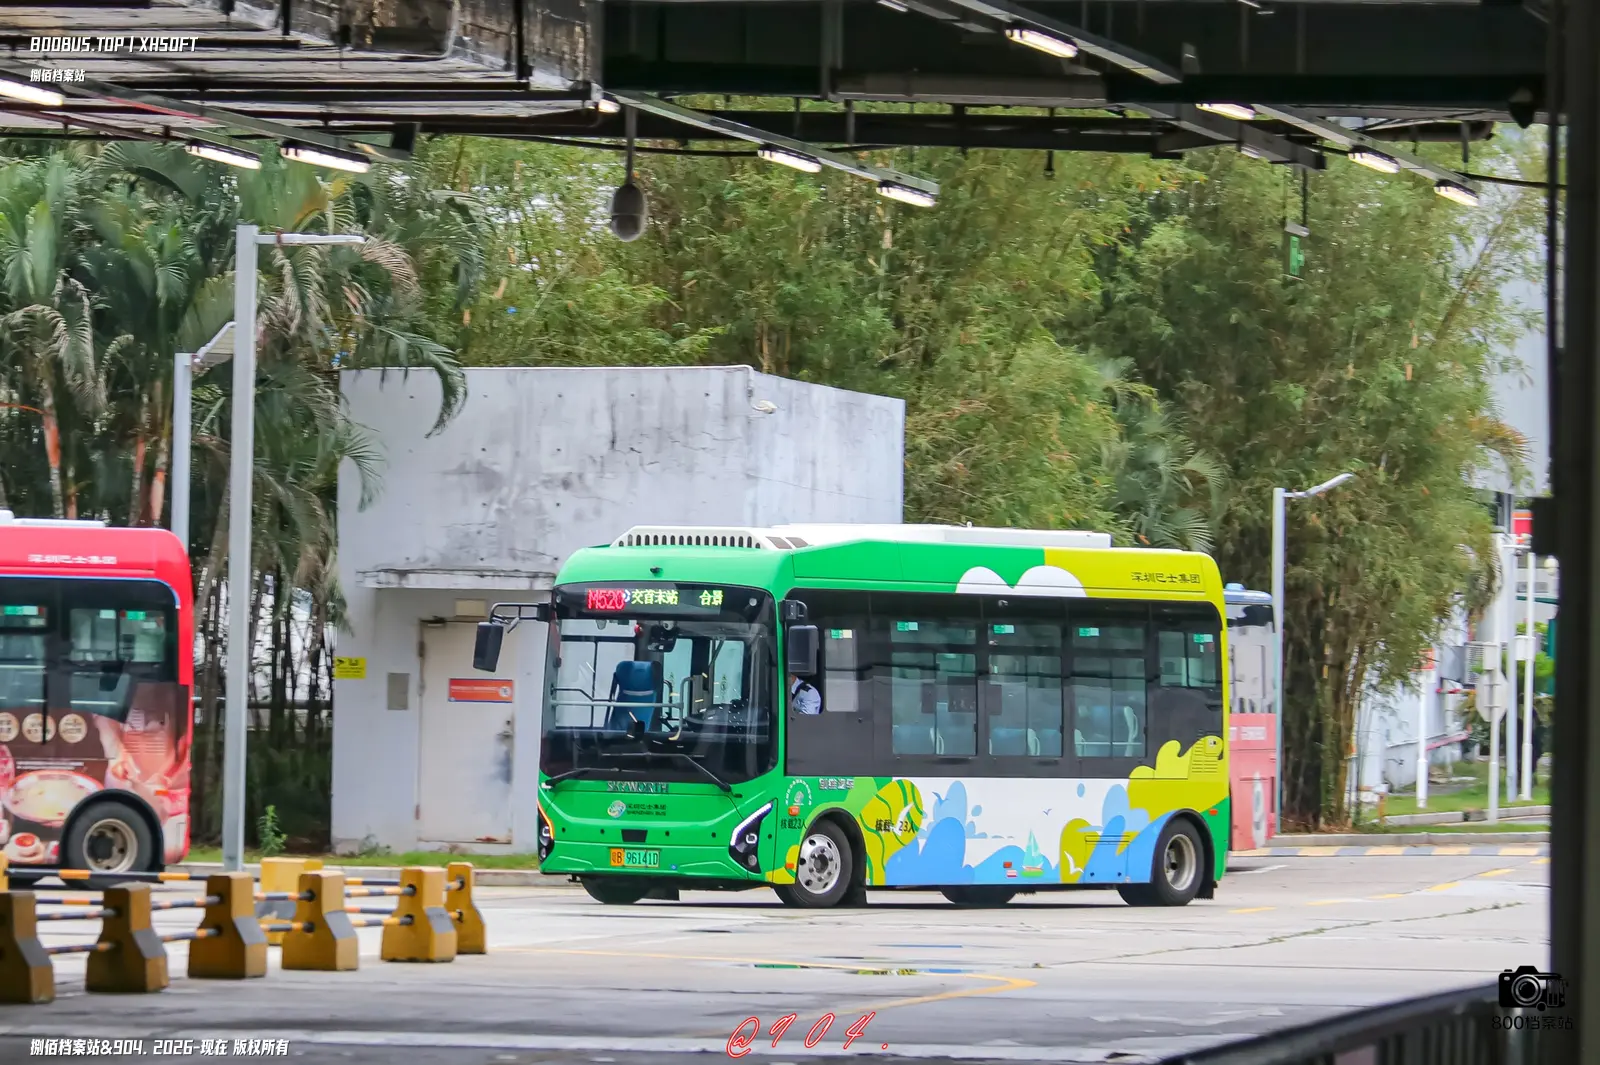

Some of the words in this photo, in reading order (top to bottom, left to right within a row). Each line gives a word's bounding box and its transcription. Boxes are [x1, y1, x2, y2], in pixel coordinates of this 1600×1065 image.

[1130, 571, 1201, 584] 深圳巴士集团
[587, 589, 625, 610] M520
[607, 780, 670, 793] SKYWORTH
[626, 852, 658, 866] 96141D
